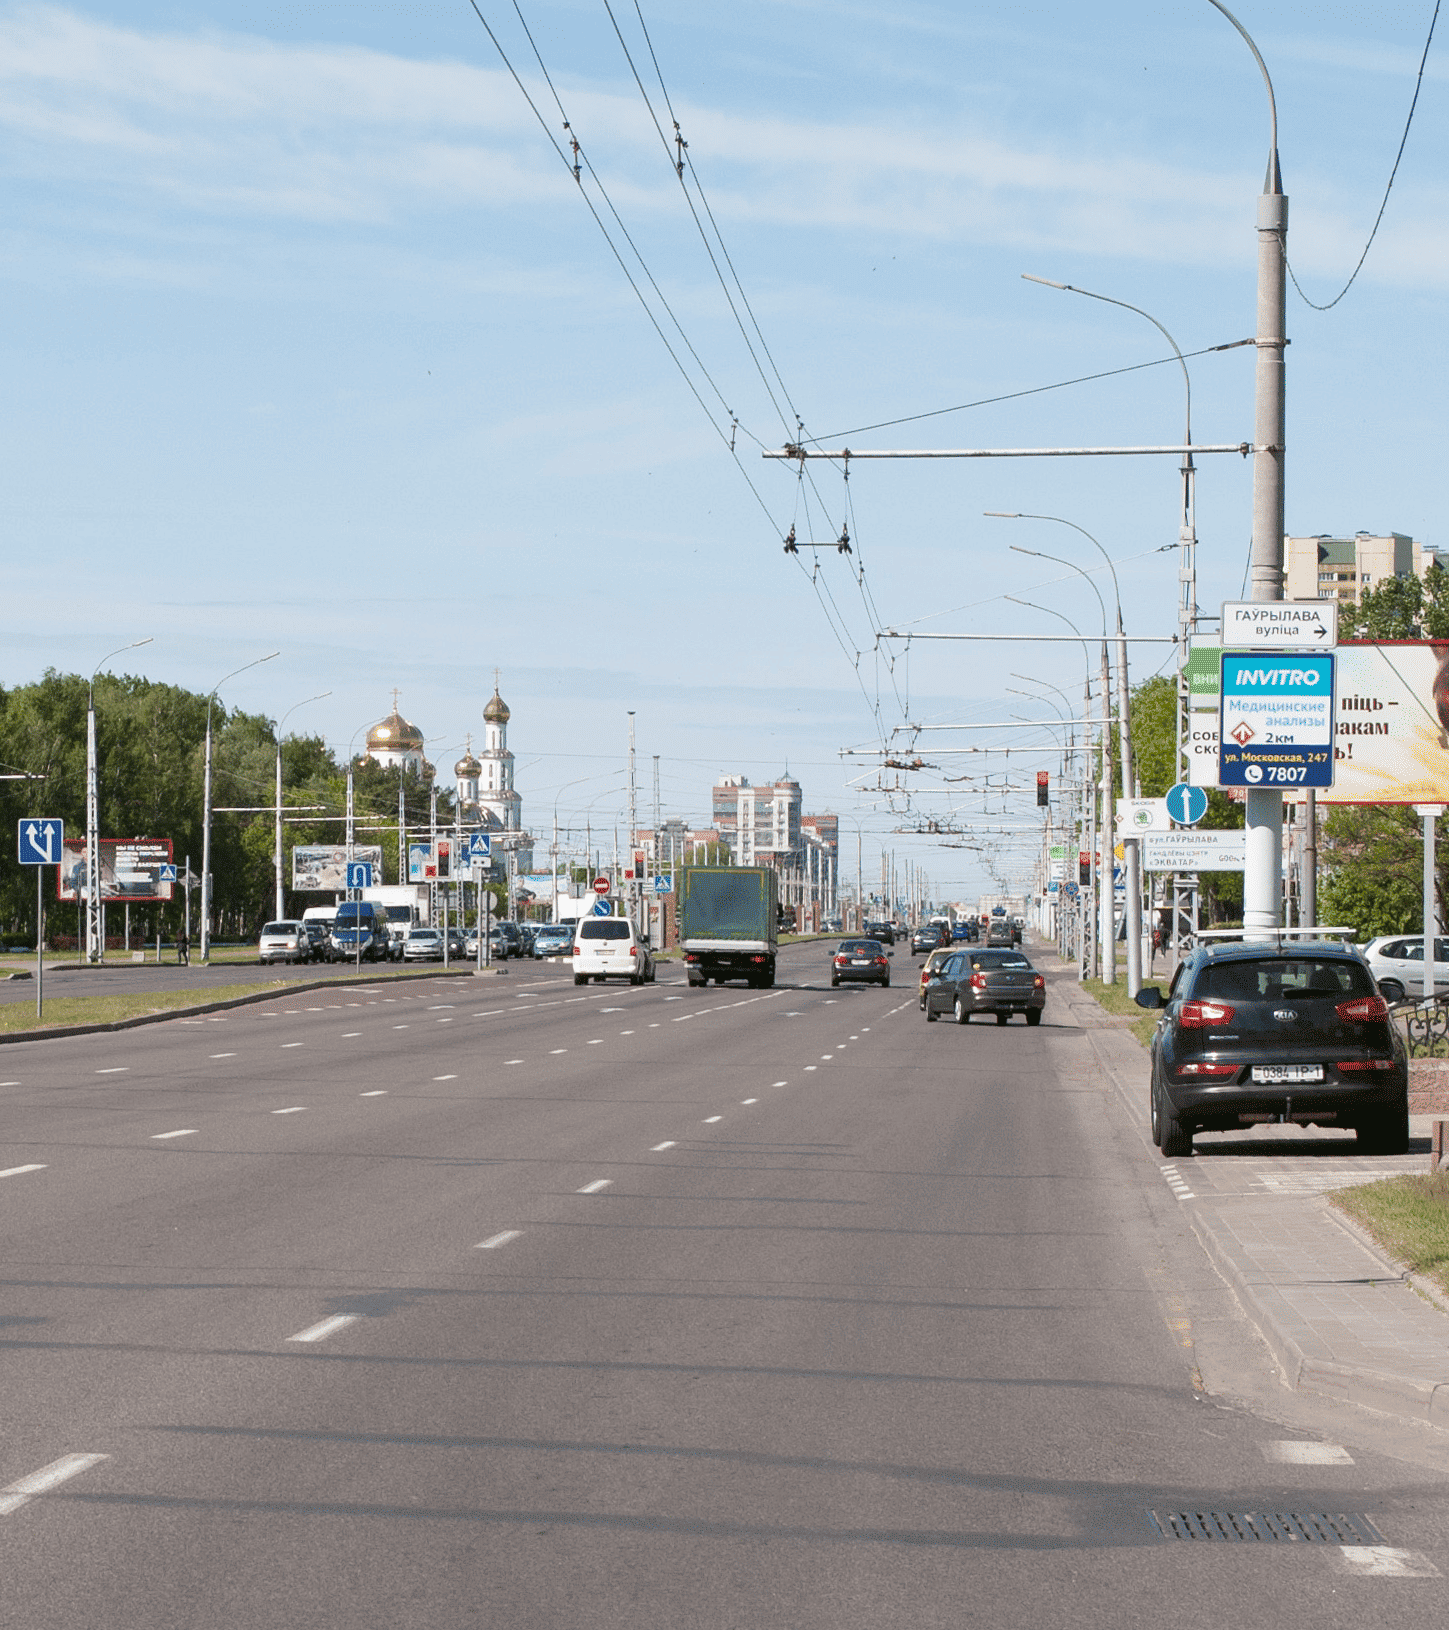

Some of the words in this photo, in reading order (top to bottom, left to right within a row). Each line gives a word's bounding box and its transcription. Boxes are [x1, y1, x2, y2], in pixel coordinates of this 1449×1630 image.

[1235, 608, 1321, 622] ГАЎРЫЛАВА
[1255, 625, 1299, 637] вуліца
[1235, 669, 1320, 686] INVITRO
[1229, 699, 1325, 713] Медицинские
[1341, 694, 1384, 712] піць
[1265, 716, 1325, 727] анализы
[1224, 754, 1240, 765] ул.
[1241, 753, 1305, 765] Московская,
[1307, 753, 1328, 763] 247
[1267, 767, 1307, 782] 7807
[1262, 1066, 1289, 1079] 0384
